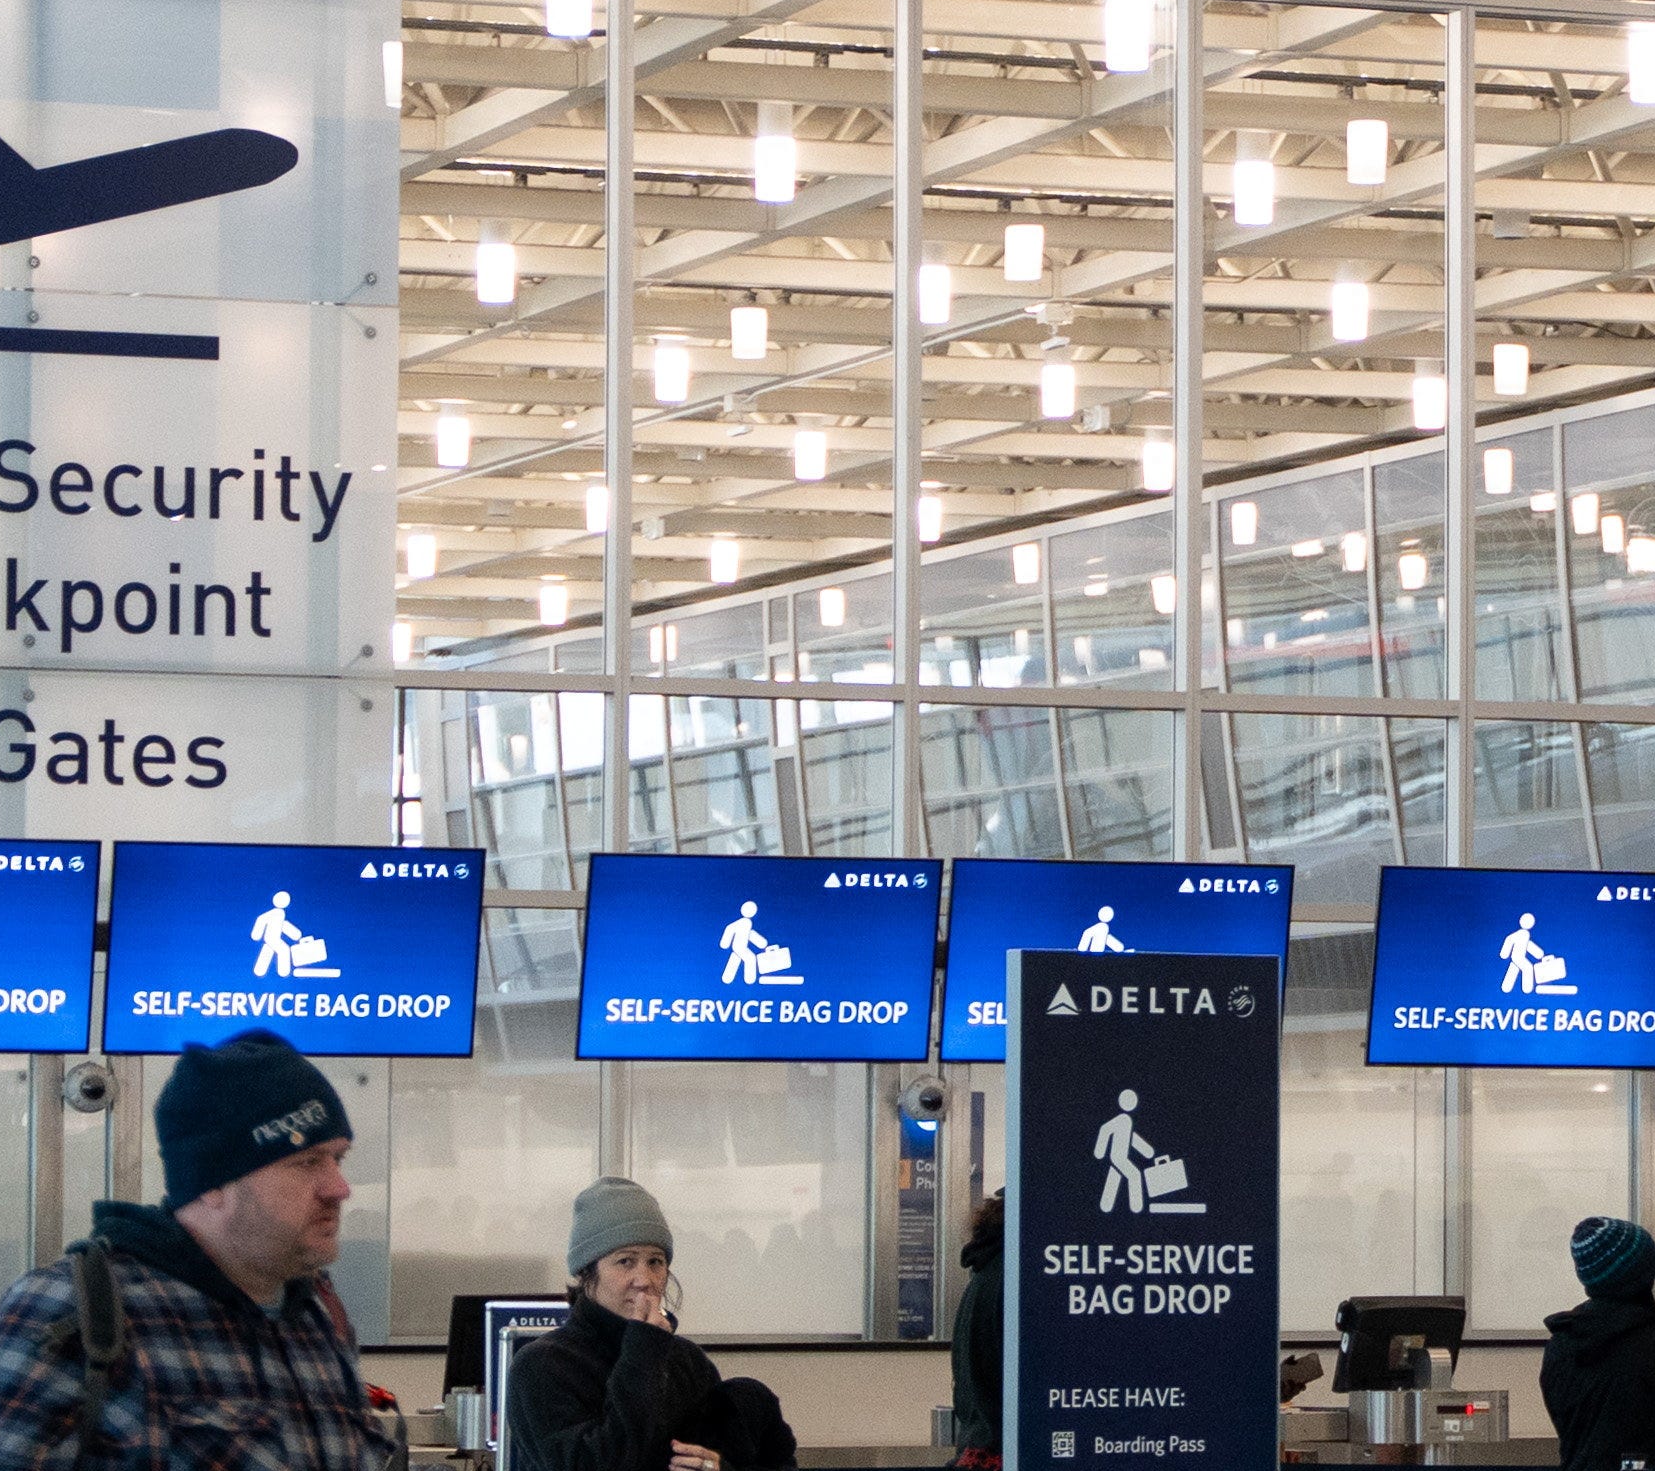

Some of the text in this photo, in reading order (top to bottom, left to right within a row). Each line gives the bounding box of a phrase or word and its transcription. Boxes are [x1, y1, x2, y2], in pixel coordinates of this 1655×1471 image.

[382, 863, 448, 878] DELTA
[846, 873, 908, 888] DELTA
[1199, 878, 1261, 893] DELTA
[133, 992, 451, 1019] SELF-SERVICE BAG DROP
[606, 998, 908, 1024] SELF-SERVICE BAG DROP
[1091, 986, 1216, 1015] DELTA
[1394, 1007, 1550, 1031] SELF-SERVICE
[1554, 1009, 1603, 1032] BAG
[1044, 1244, 1254, 1275] SELF-SERVICE
[1069, 1285, 1231, 1314] BAG DROP
[520, 1317, 557, 1326] DELTA
[1049, 1386, 1186, 1408] PLEASE HAVE:
[1095, 1435, 1206, 1456] Boarding Pass
